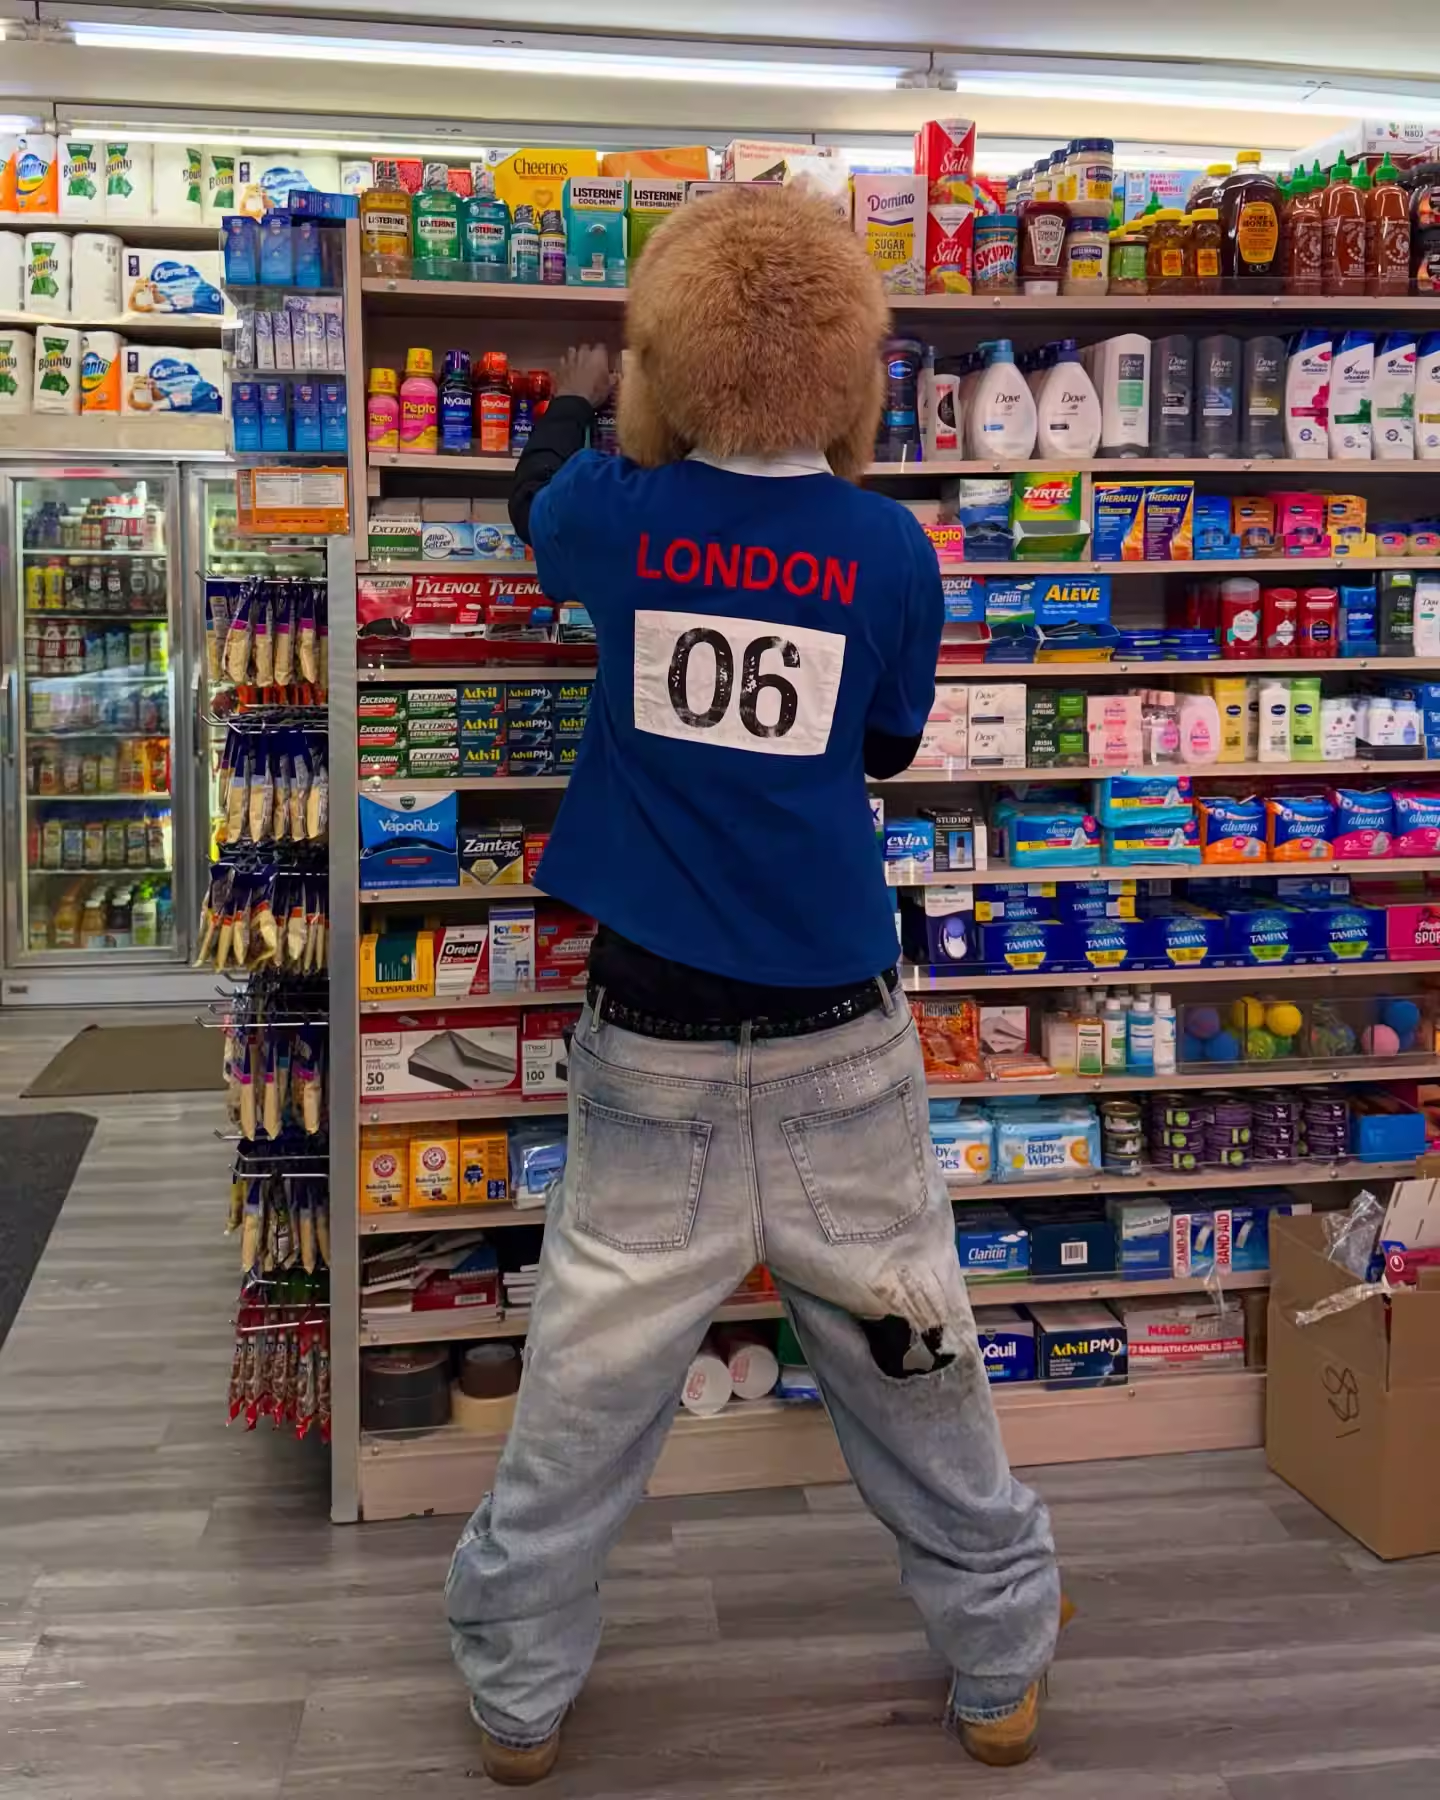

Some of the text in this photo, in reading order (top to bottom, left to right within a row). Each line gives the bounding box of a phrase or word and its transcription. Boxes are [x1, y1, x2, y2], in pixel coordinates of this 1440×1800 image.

[63, 159, 97, 178] Bounty
[513, 158, 568, 176] Cheerios
[940, 152, 968, 173] Salt
[573, 187, 622, 199] LISTERINE
[634, 190, 683, 201] LISTERINE
[867, 192, 915, 212] Domino
[368, 216, 405, 225] LISTERINE
[420, 220, 456, 228] LISTERINE
[1242, 220, 1274, 228] HONEY
[468, 226, 503, 235] LISTERINE
[874, 239, 905, 249] SUGAR
[873, 250, 906, 260] PACKETS
[933, 243, 963, 263] Salt
[975, 245, 1015, 270] SKIPPY
[28, 258, 59, 277] Bounty
[38, 356, 72, 371] Bounty
[443, 396, 472, 407] NyQuil
[995, 392, 1020, 404] Dove
[1061, 391, 1087, 403] Dove
[402, 401, 437, 417] Pepto
[481, 400, 510, 410] DayQuil
[369, 413, 393, 423] Pepto
[1022, 485, 1072, 499] ZYRTEC
[1147, 494, 1188, 502] THERAFLU
[1100, 494, 1139, 503] THERAFLU
[371, 525, 418, 534] EXCEDRIN
[423, 540, 452, 549] Seltzer
[636, 531, 859, 606] LONDON
[415, 579, 482, 596] TYLENOL
[488, 579, 543, 597] TYLENO
[941, 577, 973, 592] epcid
[988, 591, 1021, 603] Claritin
[1044, 584, 1100, 601] ALEVE
[667, 627, 801, 739] 06
[411, 692, 455, 700] EXCEDRIN
[463, 687, 497, 699] Advil
[509, 688, 546, 698] Advil PM
[360, 695, 398, 704] EXCEDRIN
[360, 725, 398, 733] EXCEDRIN
[411, 722, 455, 730] EXCEDRIN
[463, 718, 498, 730] Advil
[511, 719, 548, 729] Advil PM
[361, 754, 399, 763] EXCEDRIN
[412, 752, 457, 761] EXCEDRIN
[466, 749, 500, 761] Advil
[511, 750, 548, 759] Advil PM
[936, 816, 971, 824] STUD 100
[1348, 812, 1385, 827] always
[1408, 811, 1440, 826] alway
[378, 818, 440, 836] VapoRub
[1220, 820, 1258, 836] always
[1287, 821, 1326, 837] always
[463, 839, 521, 853] Zantac
[1072, 902, 1104, 911] TAMPAX
[494, 925, 509, 934] ICY
[1329, 928, 1368, 941] TAMPAX
[1085, 937, 1126, 949] TAMPAX
[1167, 934, 1207, 946] TAMPAX
[1250, 931, 1289, 944] TAMPAX
[445, 943, 479, 956] Orajel
[1004, 939, 1046, 951] TAMPAX
[366, 984, 428, 996] NEOSPORIN
[366, 1072, 385, 1086] 50
[526, 1070, 545, 1081] 100
[935, 1145, 951, 1158] by
[1027, 1143, 1057, 1156] Baby
[1027, 1152, 1065, 1167] Wipes
[1217, 1213, 1230, 1265] BAND-AID
[968, 1247, 1007, 1261] Claritin
[981, 1341, 1016, 1359] yQuil
[1050, 1337, 1114, 1357] Advil PM
[1139, 1344, 1181, 1354] SABBATH
[1182, 1343, 1221, 1353] CANDLES
